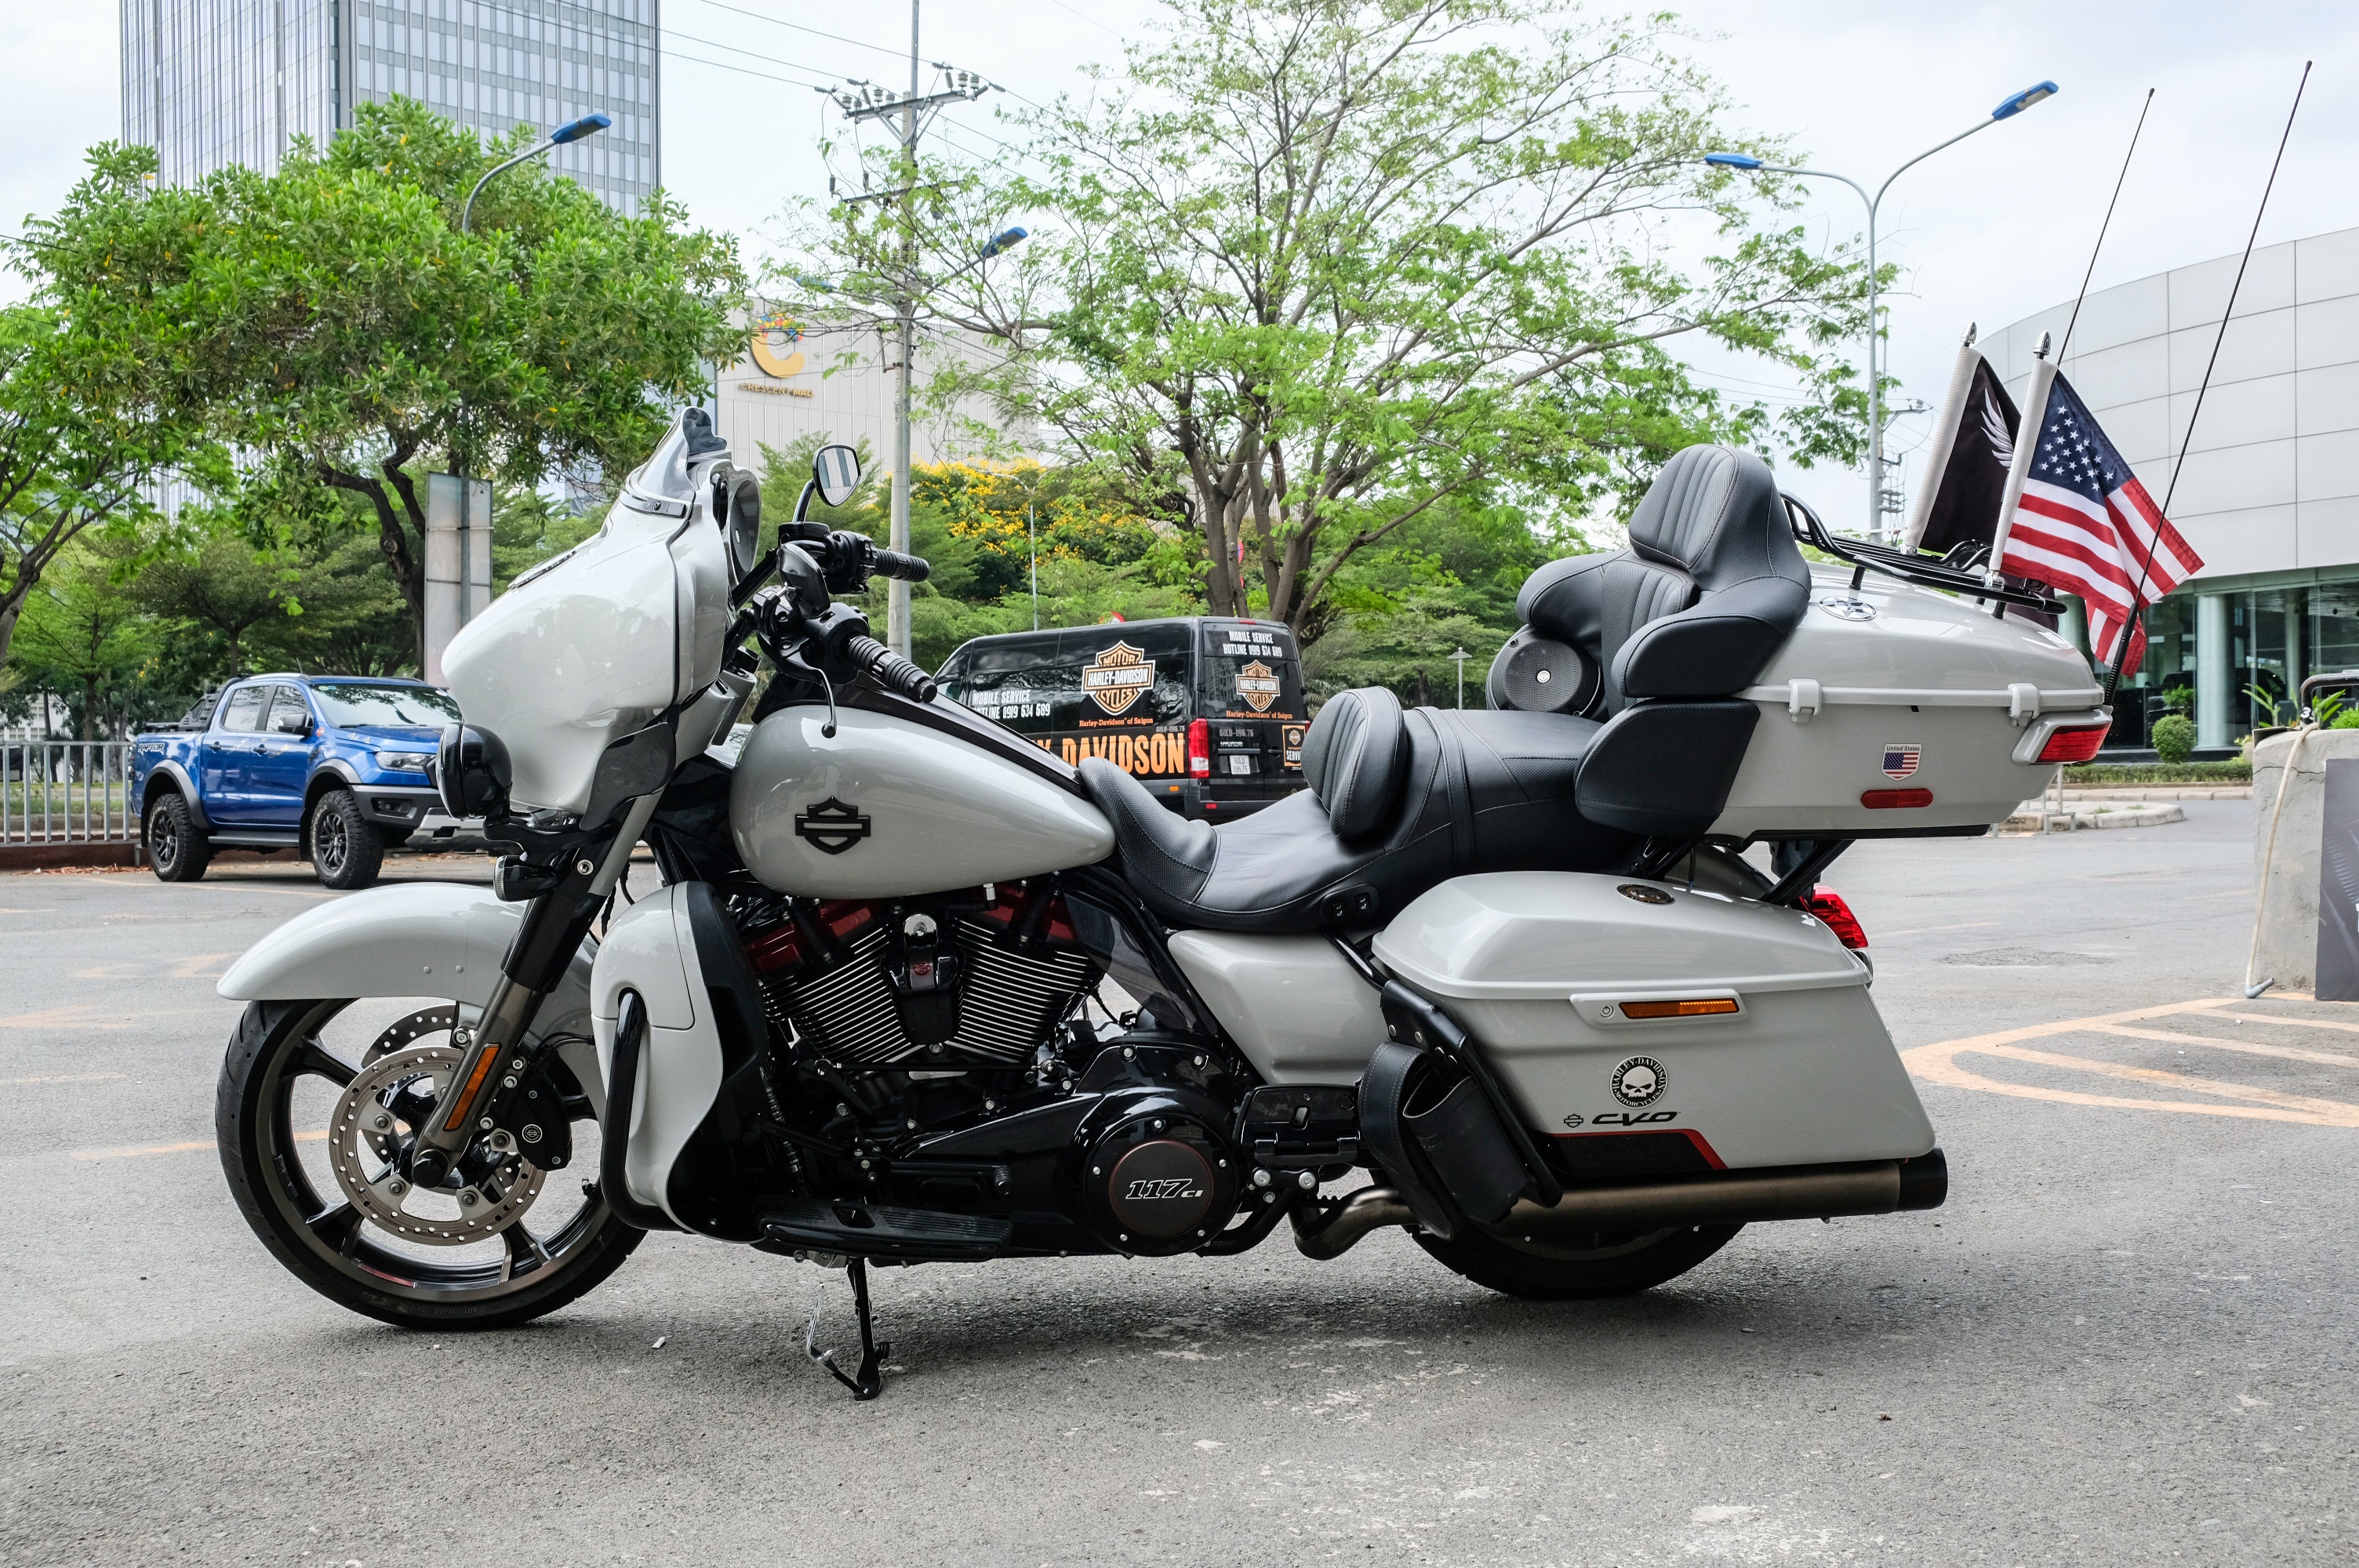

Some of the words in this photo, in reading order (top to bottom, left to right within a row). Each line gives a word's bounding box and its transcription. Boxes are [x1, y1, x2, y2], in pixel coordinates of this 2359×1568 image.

[740, 383, 789, 395] CRESCENT
[1228, 631, 1251, 642] MOBILE
[1252, 633, 1274, 644] SERVICE
[1103, 649, 1136, 666] MOTOR
[1223, 644, 1247, 655] HOTLINE
[1249, 644, 1260, 655] 0919
[1262, 645, 1271, 656] 534
[1272, 646, 1282, 657] 589
[1088, 668, 1149, 686] HARLEY-DAVIDSON
[972, 691, 998, 705] MOBILE
[1001, 690, 1030, 703] SERVICE
[1100, 688, 1132, 708] CYCLES
[1249, 694, 1269, 706] CYCLES
[972, 706, 1001, 720] OTLINE
[1002, 706, 1019, 719] 0919
[1020, 704, 1034, 717] 534
[1035, 702, 1051, 717] 589
[1133, 717, 1154, 725] Saigon
[138, 743, 165, 756] RAPTOR
[1063, 733, 1185, 774] DAVIDSON
[1286, 750, 1301, 760] SERVI
[1612, 1058, 1666, 1089] HARLEY-DAVIDSON
[1616, 1091, 1661, 1107] MOTORCYCLES
[1125, 1178, 1192, 1200] 117
